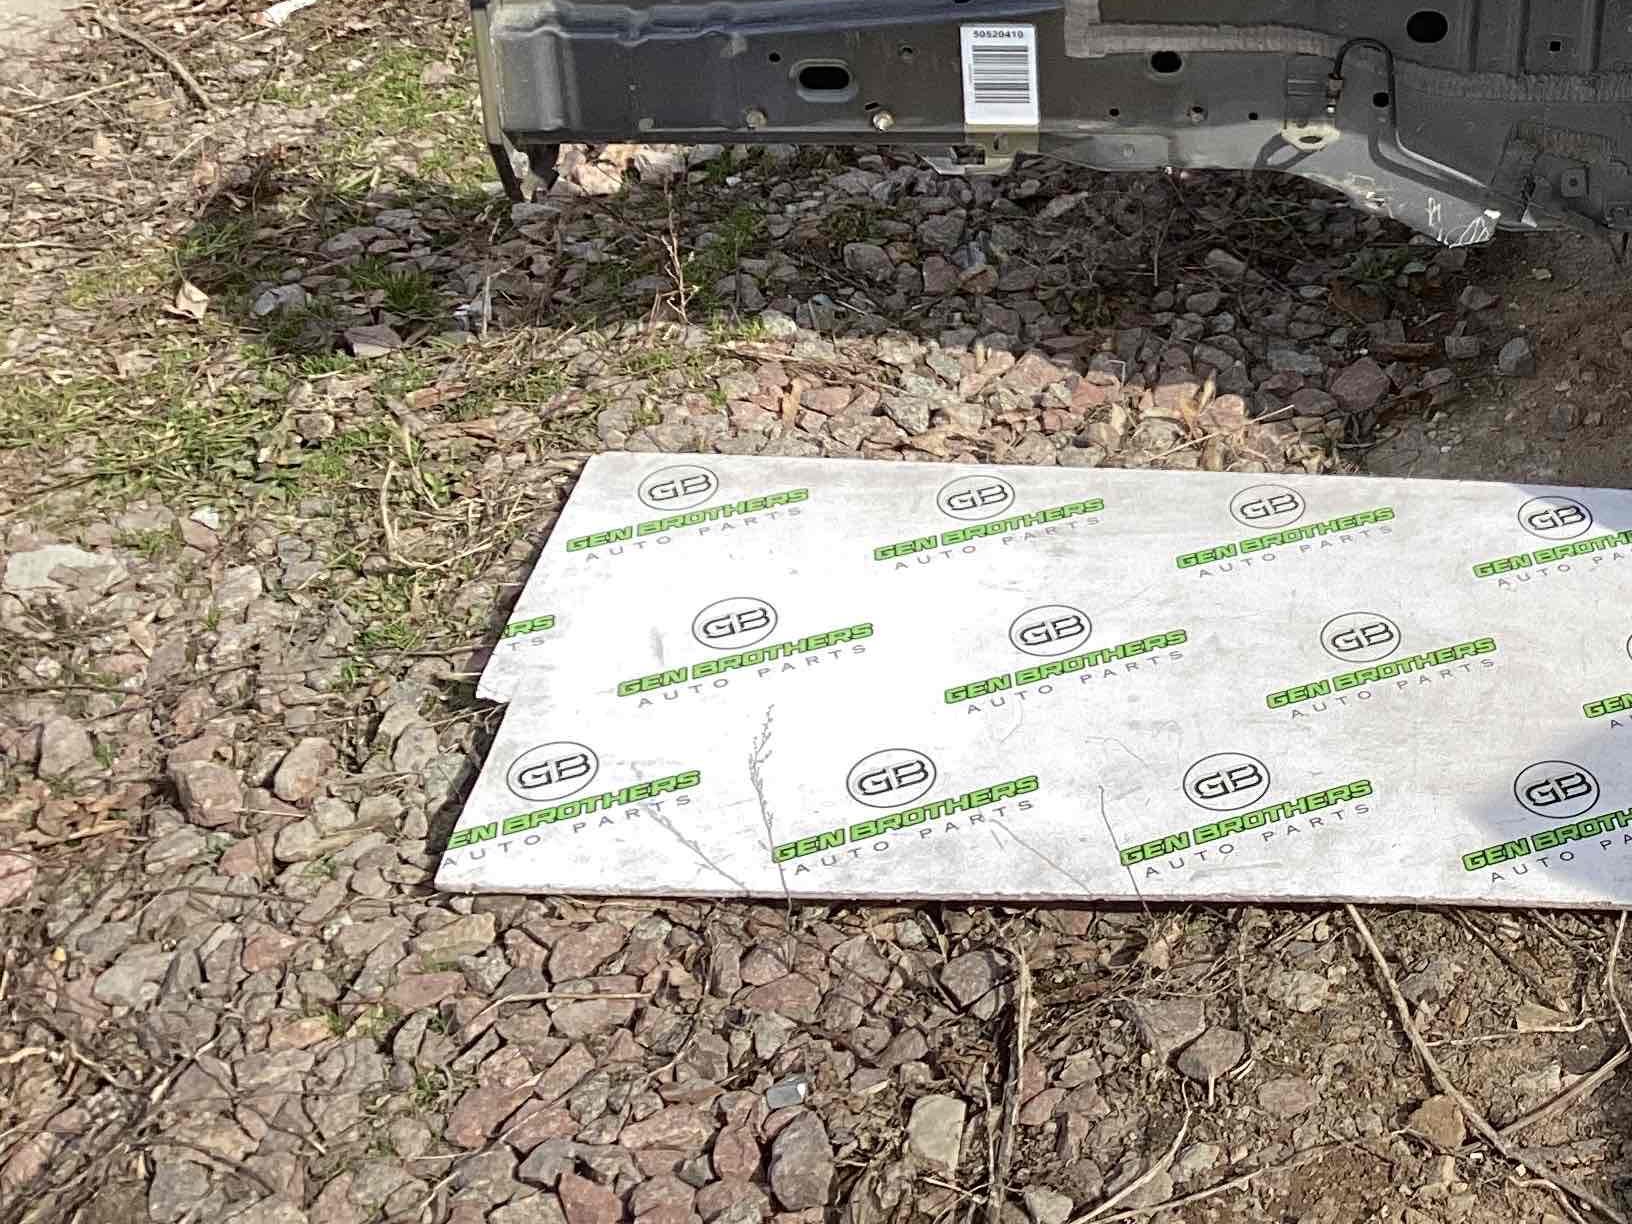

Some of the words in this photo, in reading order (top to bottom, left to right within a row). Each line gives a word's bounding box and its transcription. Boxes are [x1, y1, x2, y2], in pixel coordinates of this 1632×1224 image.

[649, 474, 712, 501] GB
[946, 483, 1008, 511] GB
[1239, 493, 1299, 520] GB
[566, 525, 633, 553] GEN
[637, 488, 809, 537] BROTHERS
[585, 536, 671, 563] AUTO
[699, 506, 804, 536] PARTS
[873, 534, 938, 562] GEN
[941, 497, 1105, 547] BROTHERS
[894, 544, 977, 571] AUTO
[1002, 516, 1101, 545] PARTS
[1176, 542, 1237, 569] GEN
[1240, 506, 1396, 554] BROTHERS
[1527, 505, 1586, 530] GB
[1198, 552, 1277, 578] AUTO
[1301, 525, 1393, 552] PARTS
[1472, 552, 1531, 578] GEN
[1496, 563, 1572, 588] AUTO
[702, 607, 770, 639] GB
[1019, 615, 1085, 646] GB
[1330, 622, 1394, 651] GB
[617, 667, 689, 697] GEN
[691, 622, 874, 679] BROTHERS
[636, 677, 730, 708] AUTO
[758, 644, 867, 678] PARTS
[944, 673, 1011, 705] GEN
[1014, 629, 1187, 686] BROTHERS
[966, 684, 1054, 715] AUTO
[1080, 649, 1186, 685] PARTS
[1266, 680, 1330, 709] GEN
[1333, 637, 1497, 691] BROTHERS
[1290, 690, 1372, 719] AUTO
[1397, 657, 1496, 690] PARTS
[517, 753, 591, 789] GB
[857, 759, 930, 796] GB
[1193, 763, 1263, 799] GB
[1525, 771, 1593, 807] GB
[441, 834, 542, 869] AUTO
[573, 794, 692, 834] PARTS
[448, 822, 498, 850] EN
[502, 770, 701, 836] BROTHERS
[771, 828, 846, 864] GEN
[849, 775, 1040, 843] BROTHERS
[794, 839, 890, 876] AUTO
[920, 799, 1034, 840] PARTS
[1119, 830, 1191, 867] GEN
[1194, 779, 1373, 845] BROTHERS
[1144, 843, 1234, 879] AUTO
[1262, 803, 1370, 842] PARTS
[1462, 837, 1532, 872] GEN
[1490, 850, 1575, 884] AUTO
